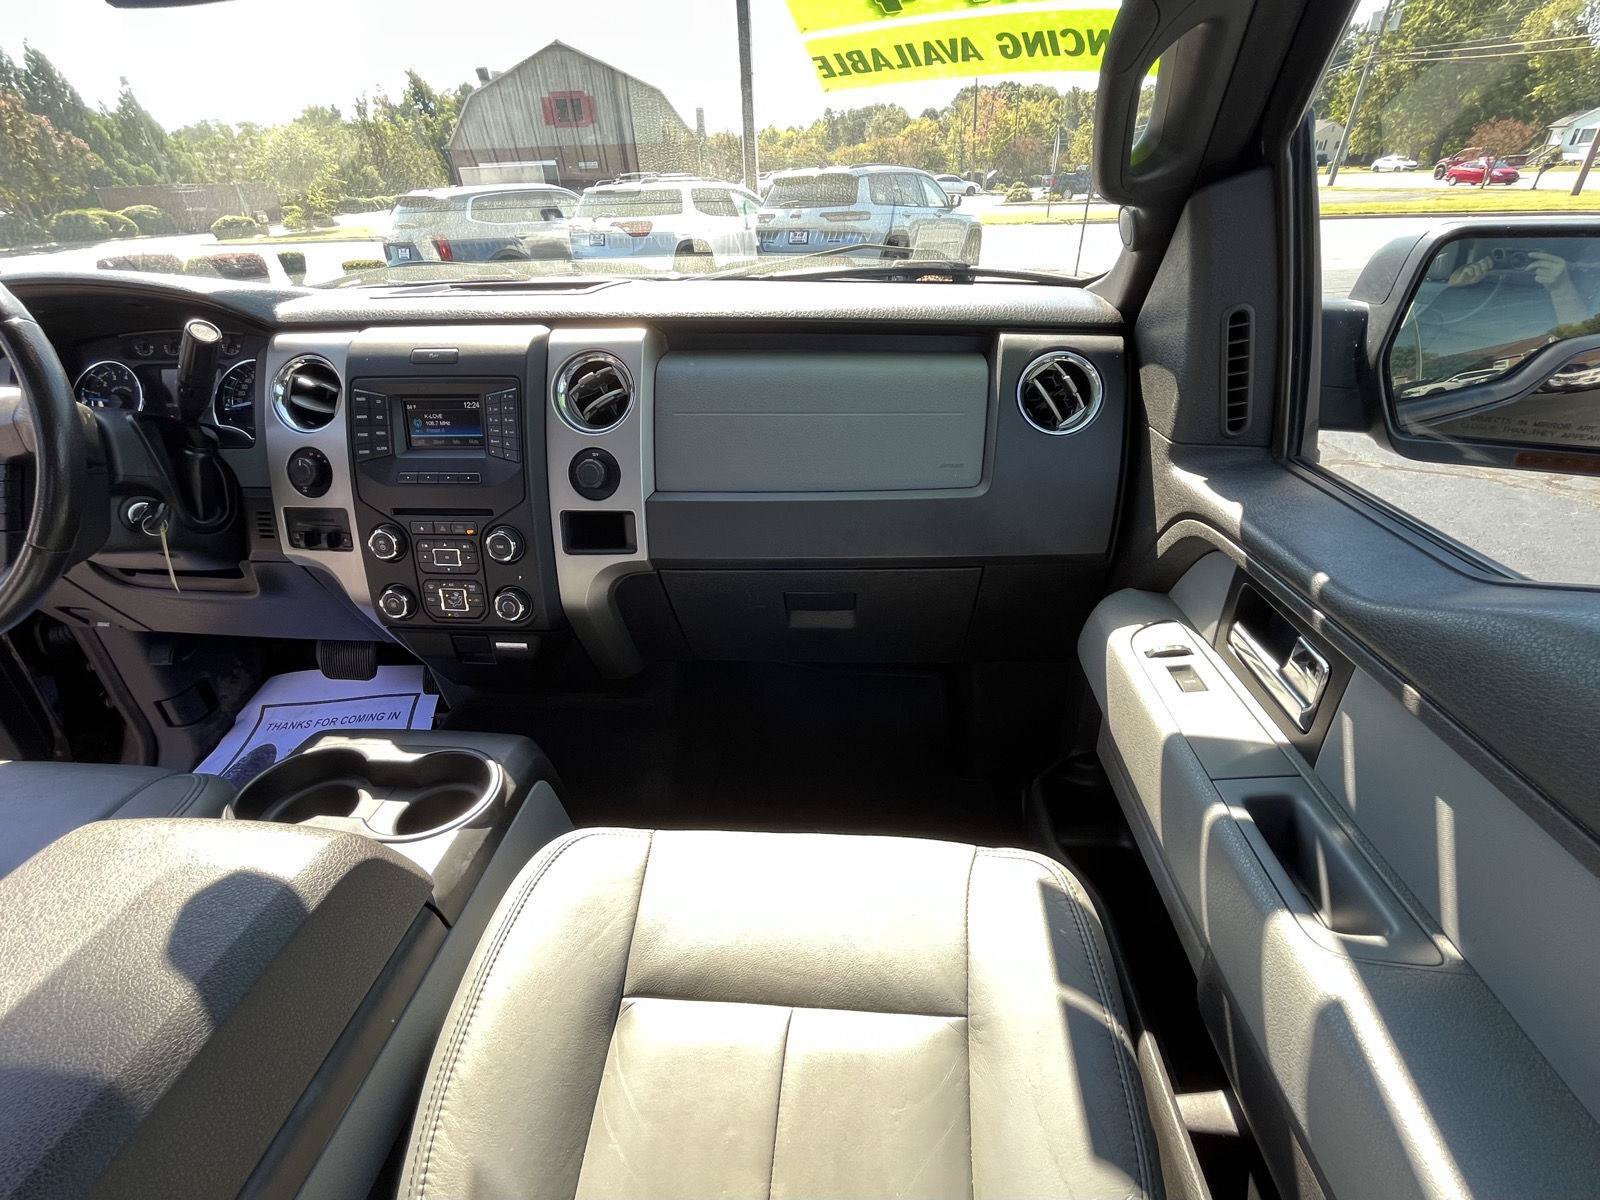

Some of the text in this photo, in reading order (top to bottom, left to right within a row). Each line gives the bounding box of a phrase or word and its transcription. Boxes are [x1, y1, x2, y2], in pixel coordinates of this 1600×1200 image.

[463, 401, 480, 409] 12:24
[266, 711, 401, 732] THANKS FOR COMING IN
